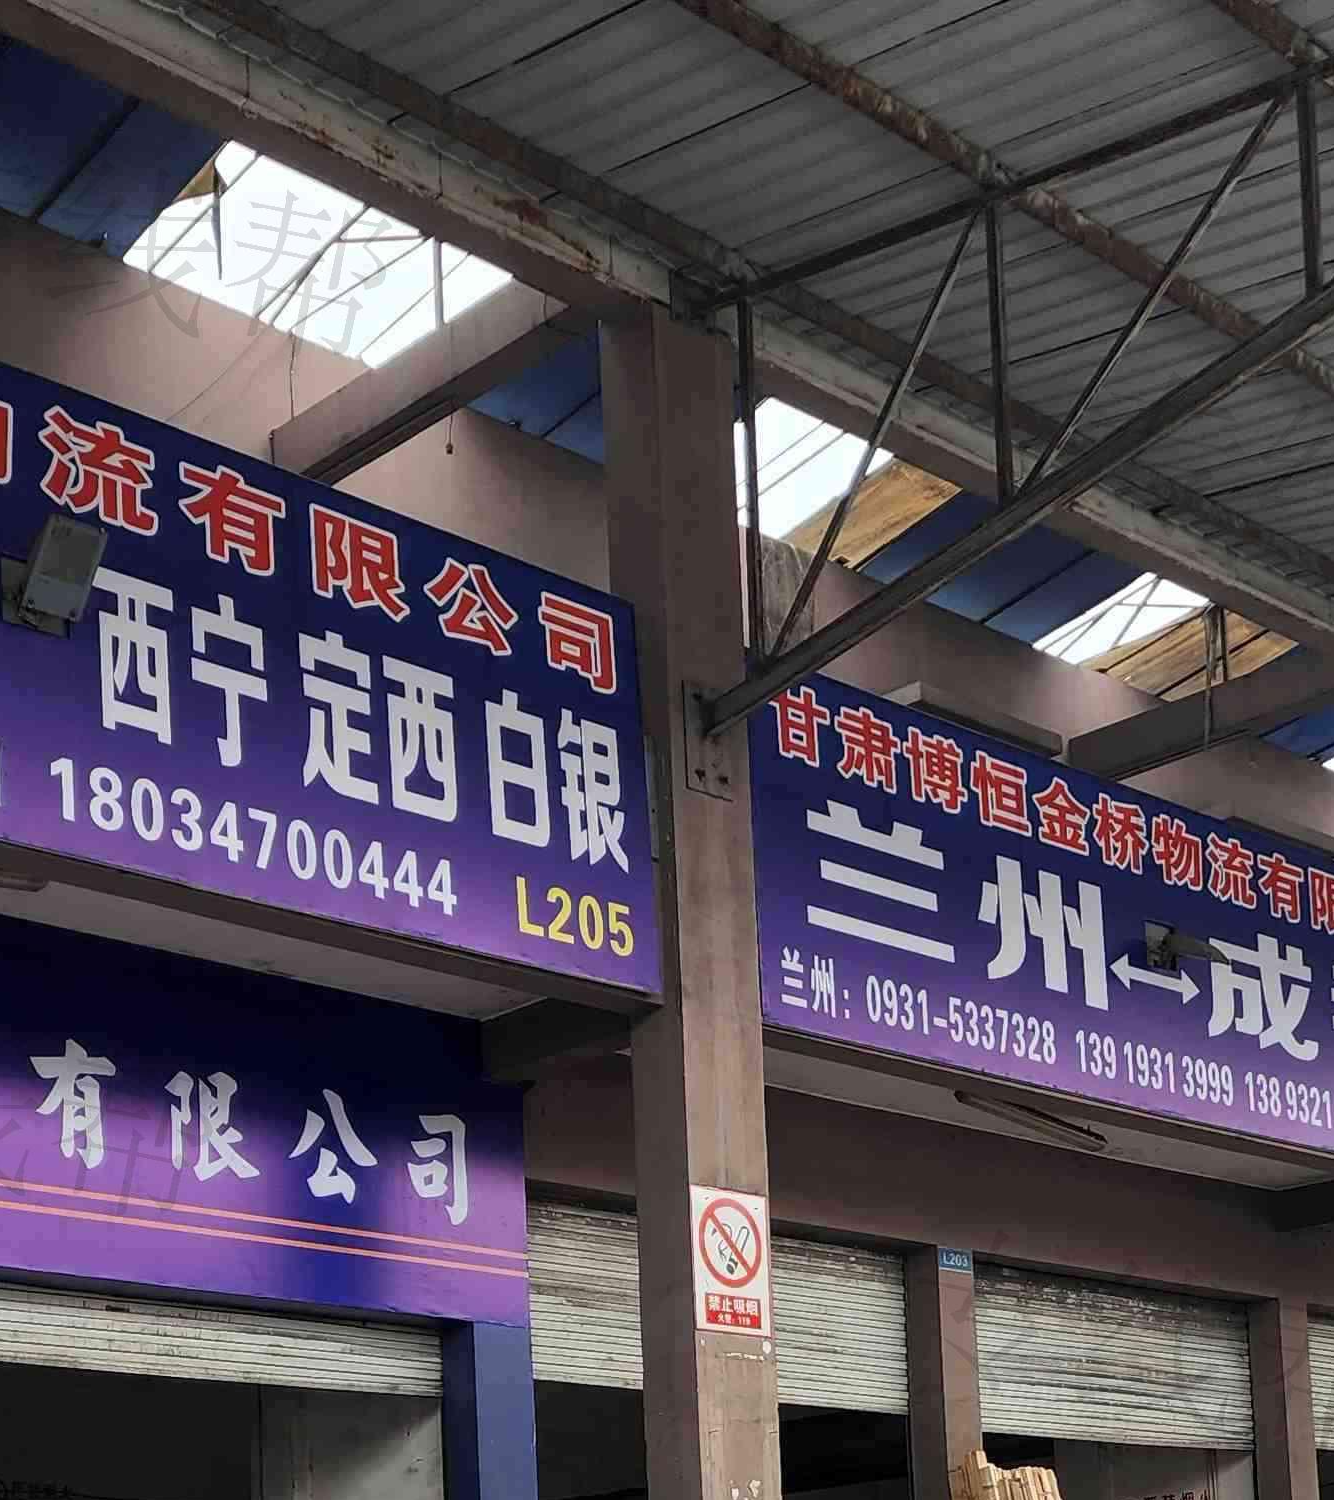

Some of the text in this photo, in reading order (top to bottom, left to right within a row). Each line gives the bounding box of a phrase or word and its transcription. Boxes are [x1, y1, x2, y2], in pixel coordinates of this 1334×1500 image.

[49, 757, 459, 918] 18034700444
[515, 876, 636, 959] L205
[484, 690, 630, 875] 白银
[805, 798, 1111, 1014] 兰州
[865, 973, 1058, 1068] 0931-5337328
[942, 1252, 970, 1269] L203
